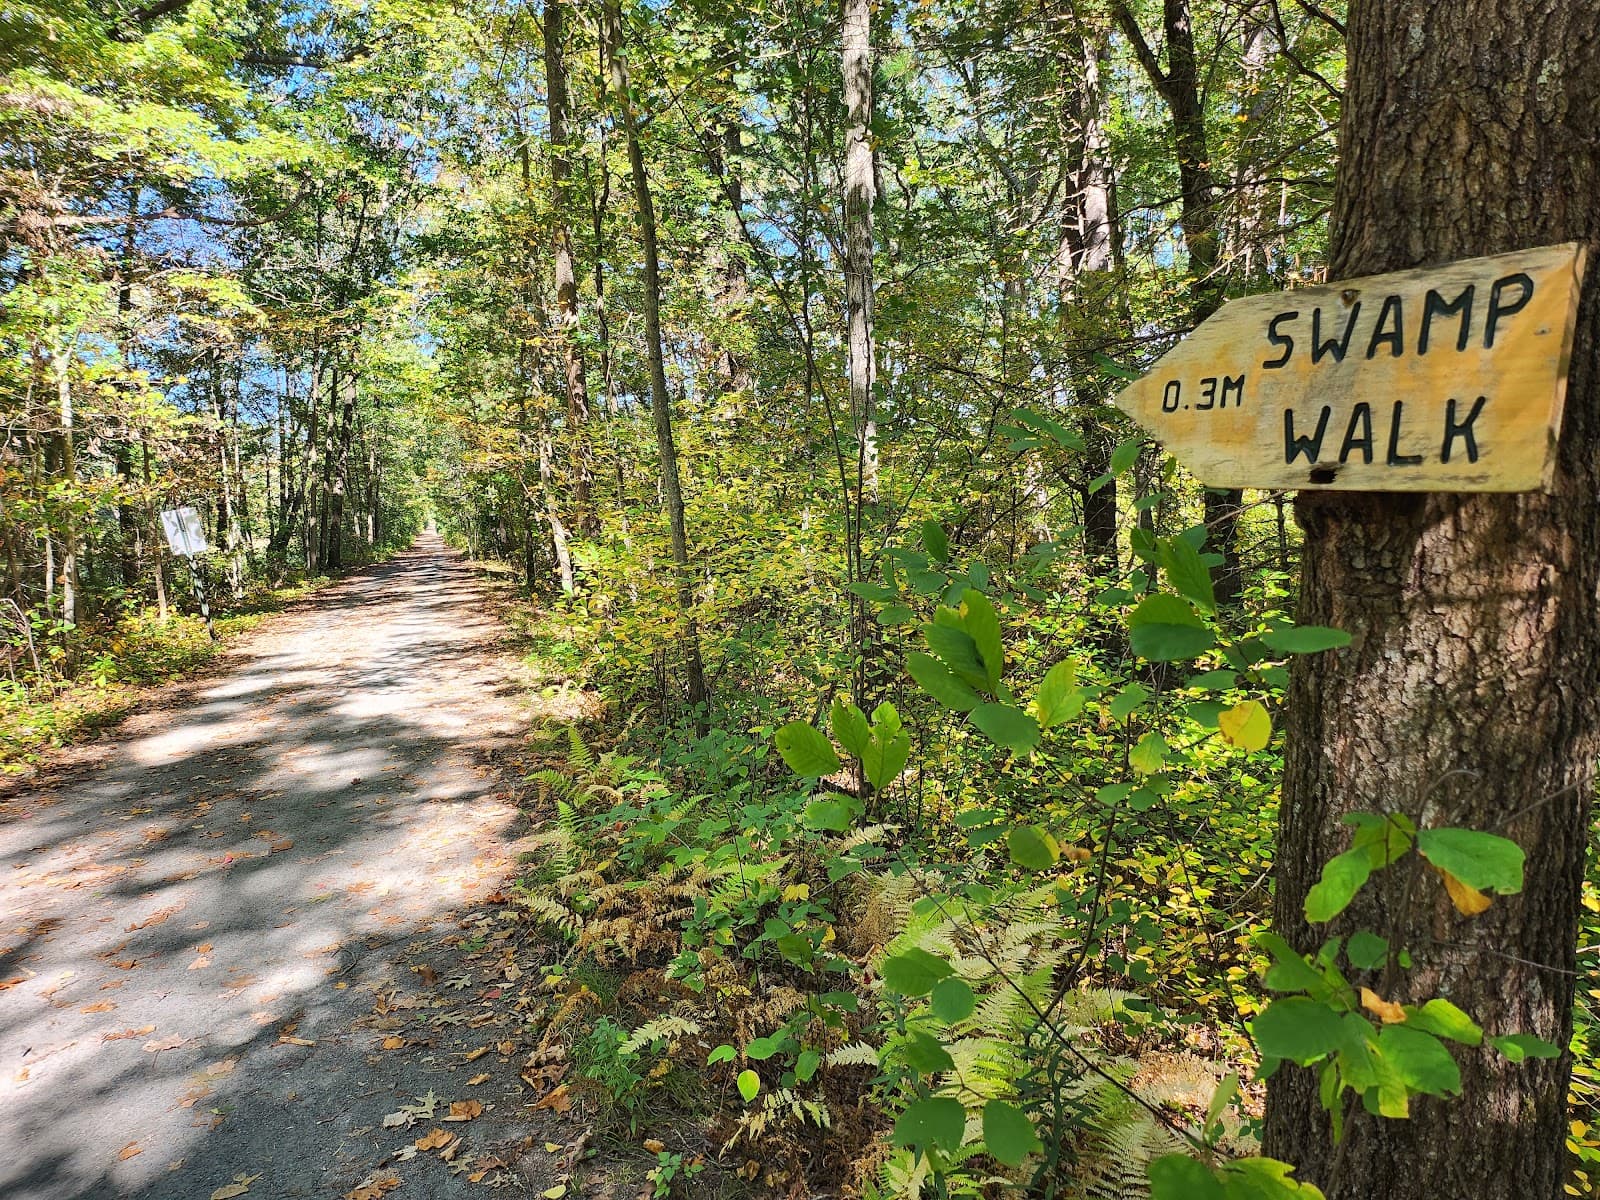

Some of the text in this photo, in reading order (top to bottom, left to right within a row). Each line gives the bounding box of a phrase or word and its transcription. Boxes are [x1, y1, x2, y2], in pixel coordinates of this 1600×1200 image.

[1262, 272, 1534, 369] SWAMP
[1161, 374, 1246, 413] 0.3M
[1283, 395, 1487, 466] WALK
